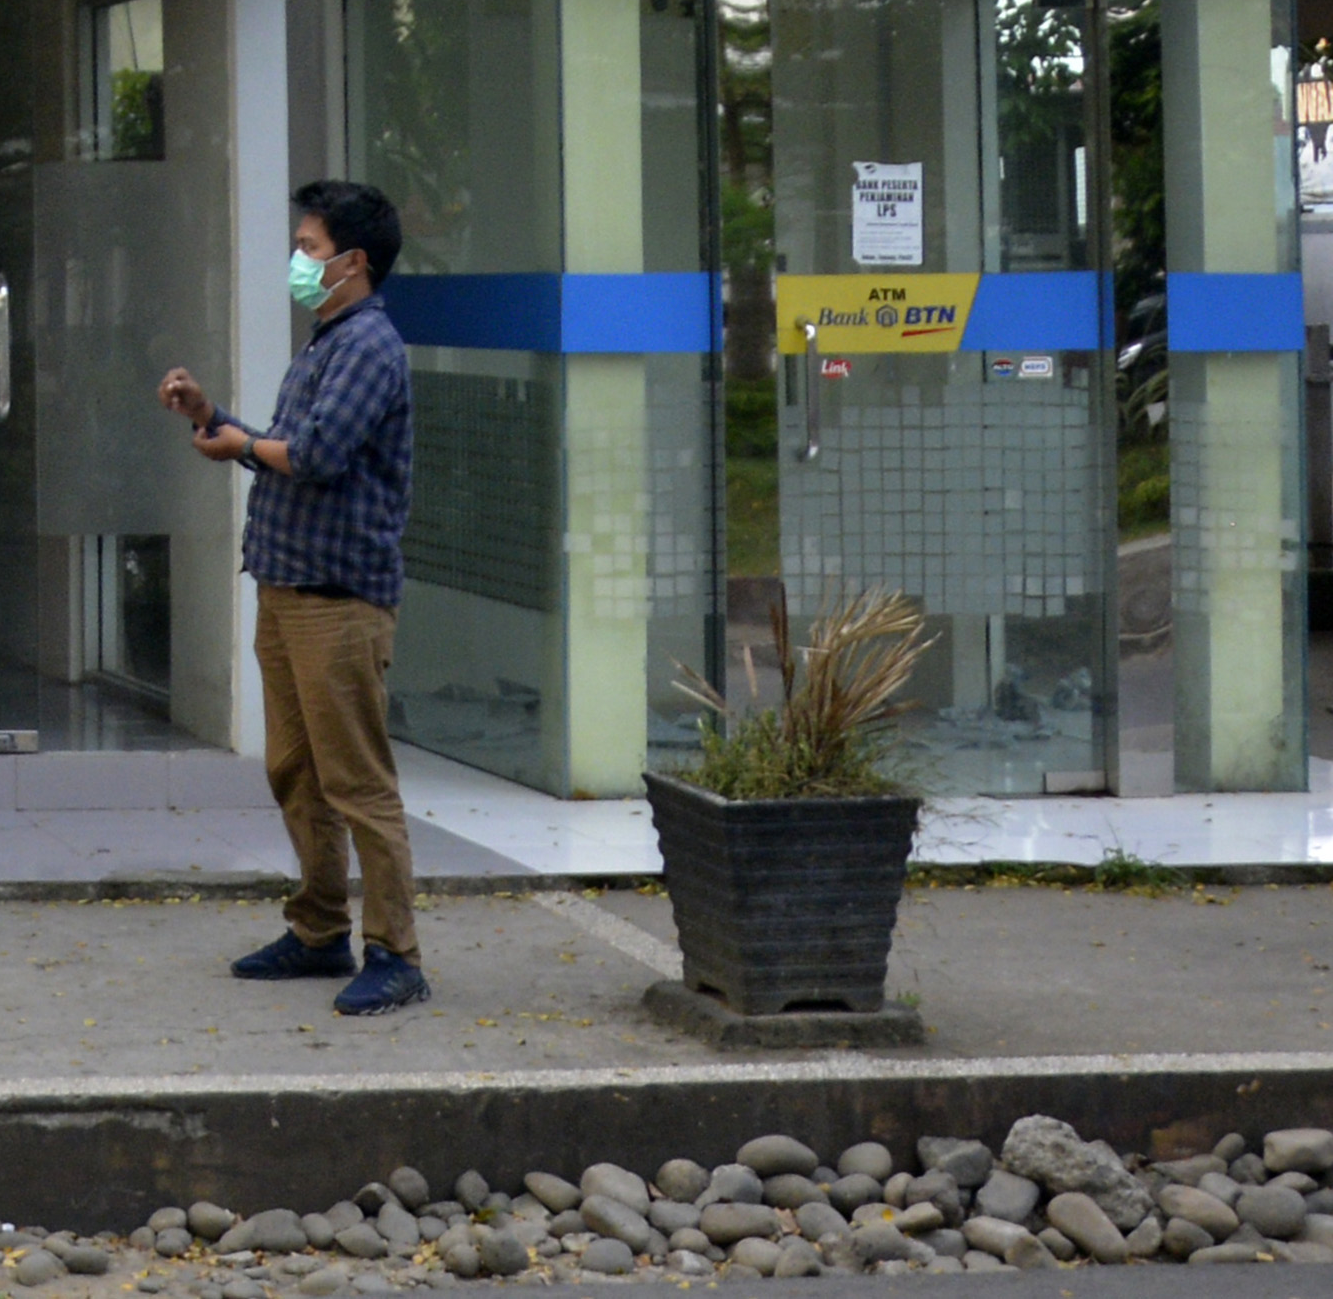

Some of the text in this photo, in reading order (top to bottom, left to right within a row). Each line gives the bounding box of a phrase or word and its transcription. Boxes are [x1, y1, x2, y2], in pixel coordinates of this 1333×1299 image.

[877, 204, 897, 217] LPS
[868, 288, 906, 301] ATM
[819, 306, 956, 326] Bank BTN
[821, 359, 849, 377] Link
